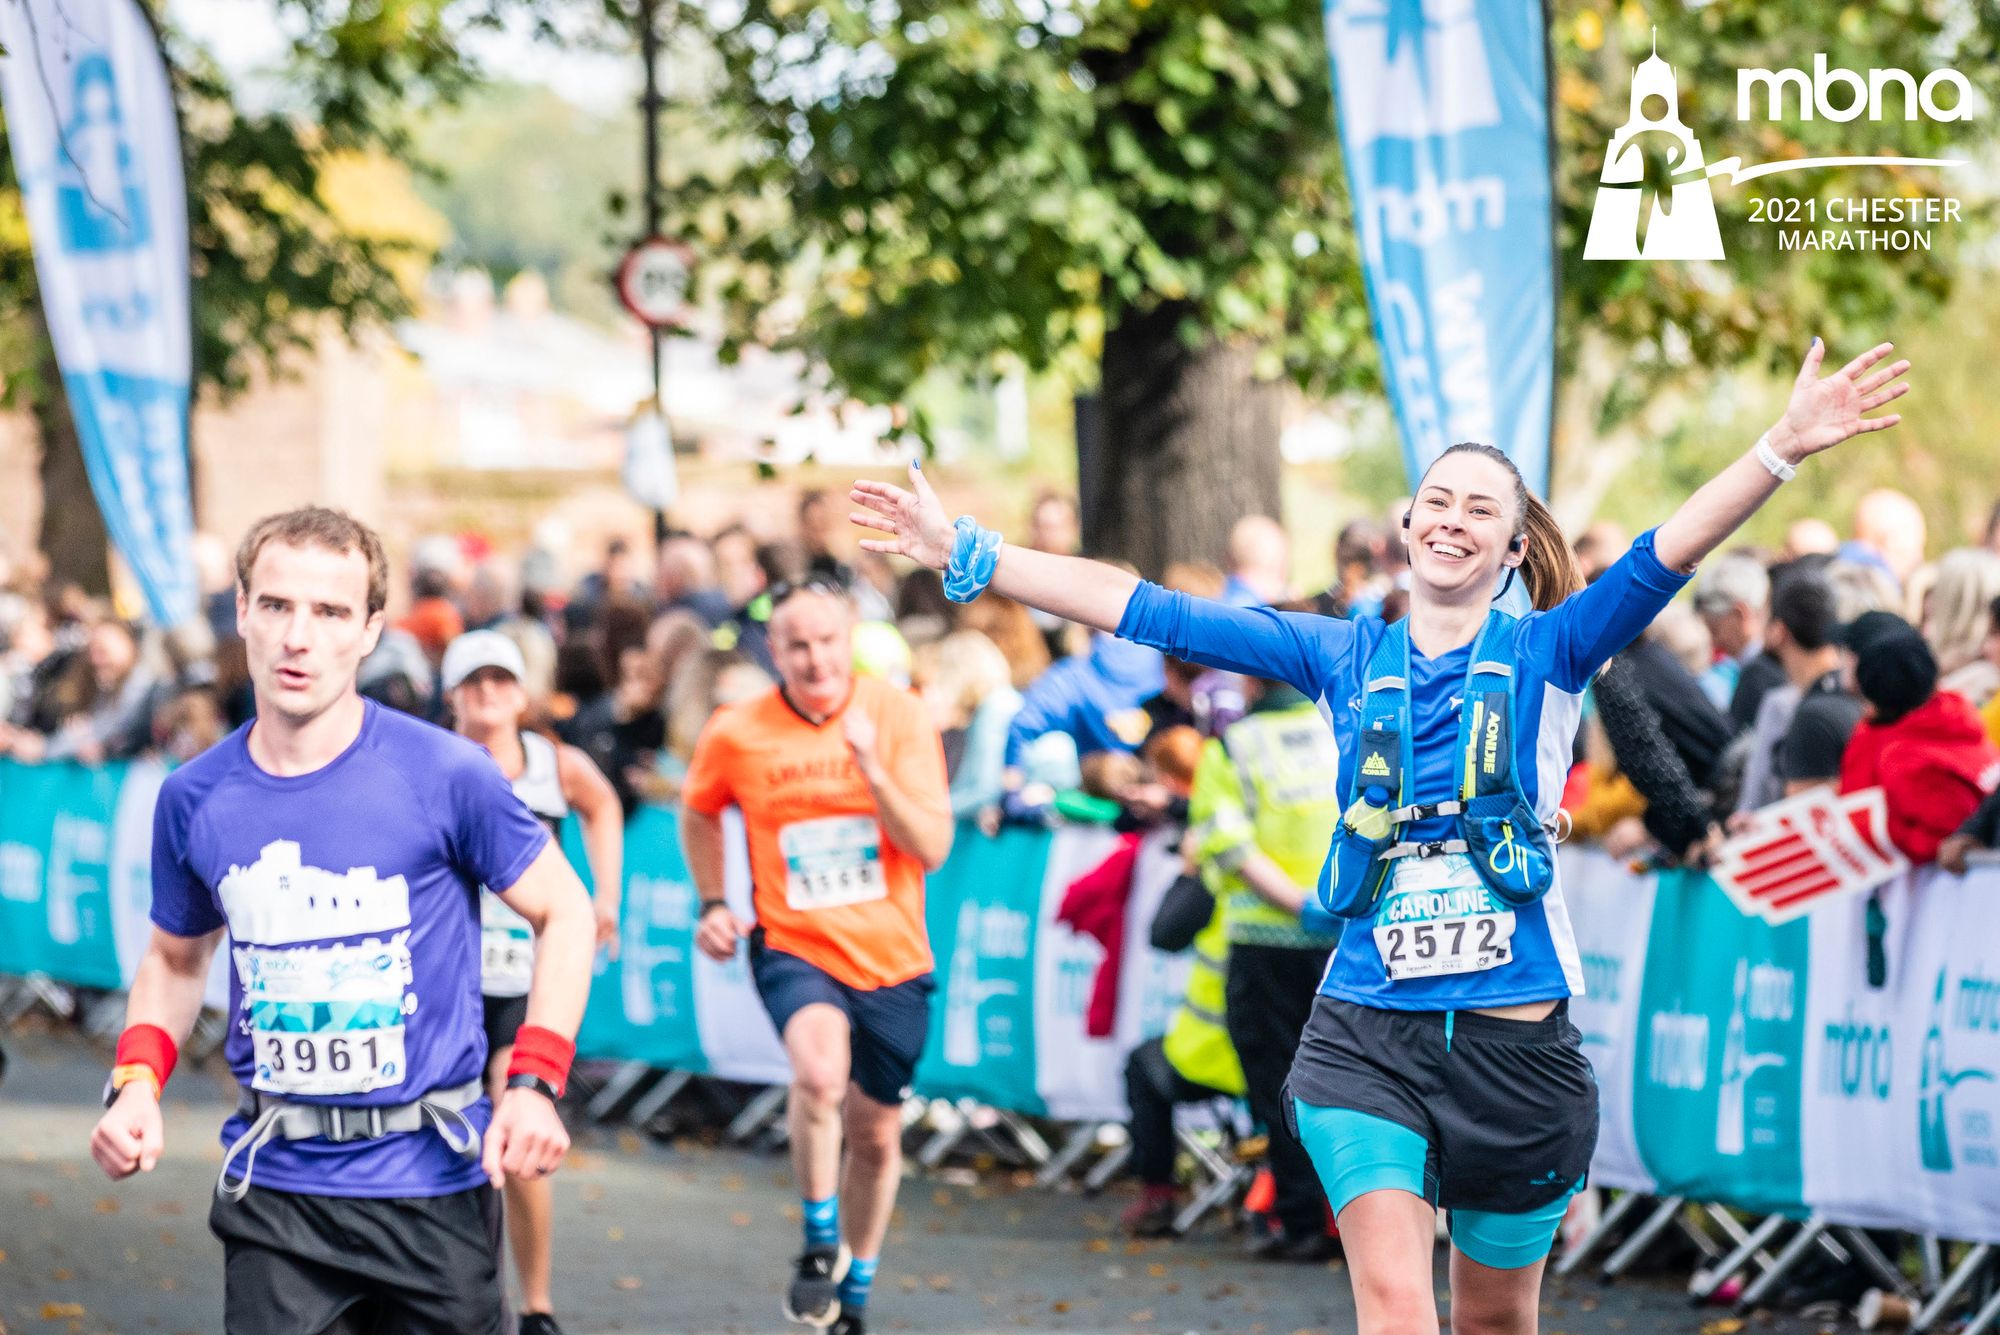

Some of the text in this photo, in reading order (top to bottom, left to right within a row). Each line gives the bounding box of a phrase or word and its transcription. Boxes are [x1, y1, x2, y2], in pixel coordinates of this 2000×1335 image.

[1389, 889, 1492, 922] CAROLINE
[1387, 918, 1497, 963] 2572
[267, 1036, 379, 1073] 3961
